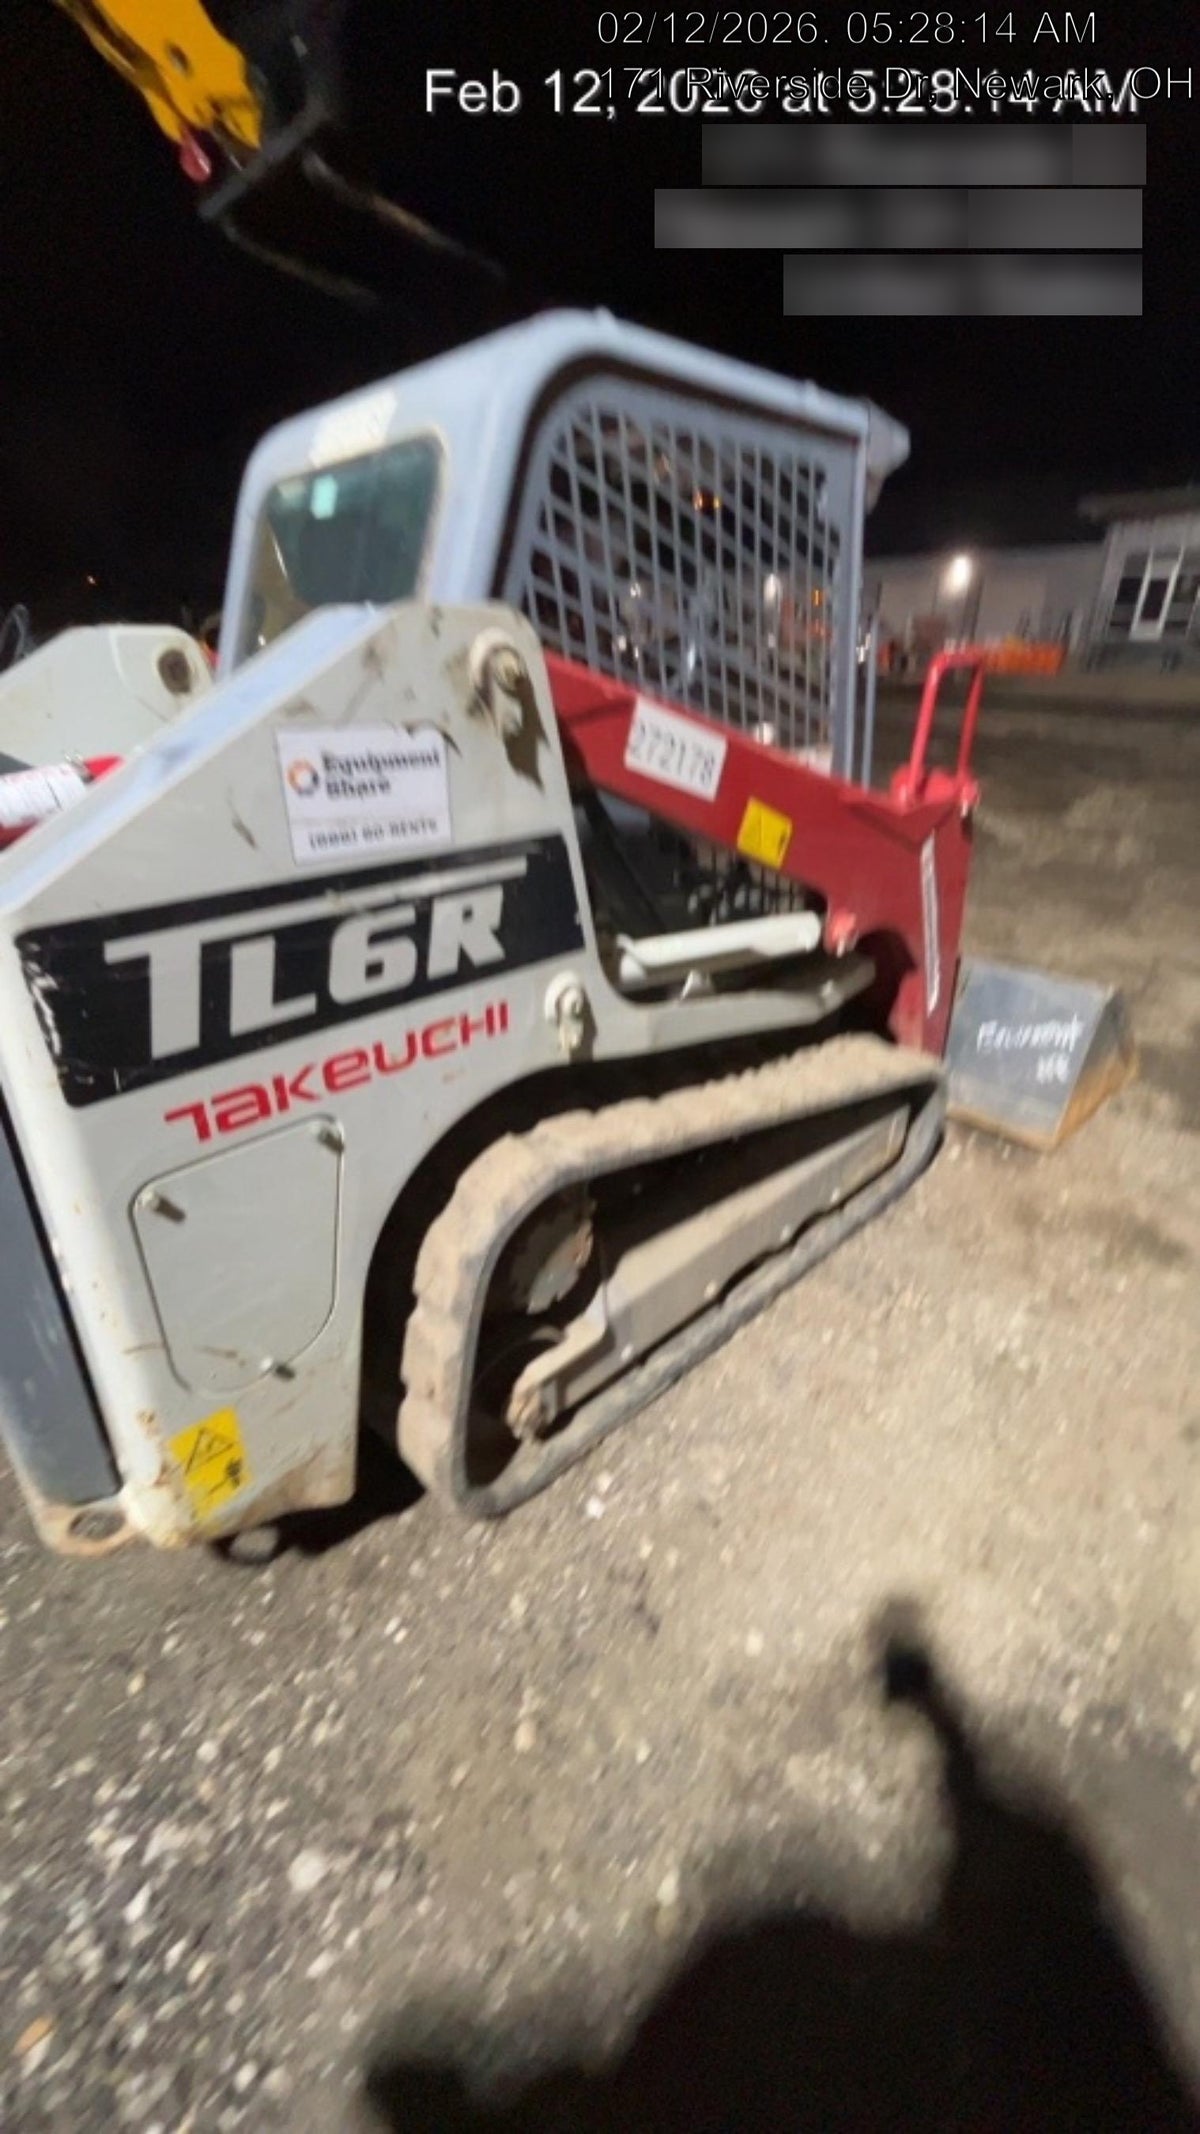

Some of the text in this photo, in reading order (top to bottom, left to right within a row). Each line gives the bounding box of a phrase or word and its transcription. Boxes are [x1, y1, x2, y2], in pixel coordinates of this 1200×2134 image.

[321, 747, 440, 776] Equipment
[325, 776, 391, 800] Share
[104, 855, 527, 1061] TL6R
[164, 1001, 510, 1143] TAKEUCHI
